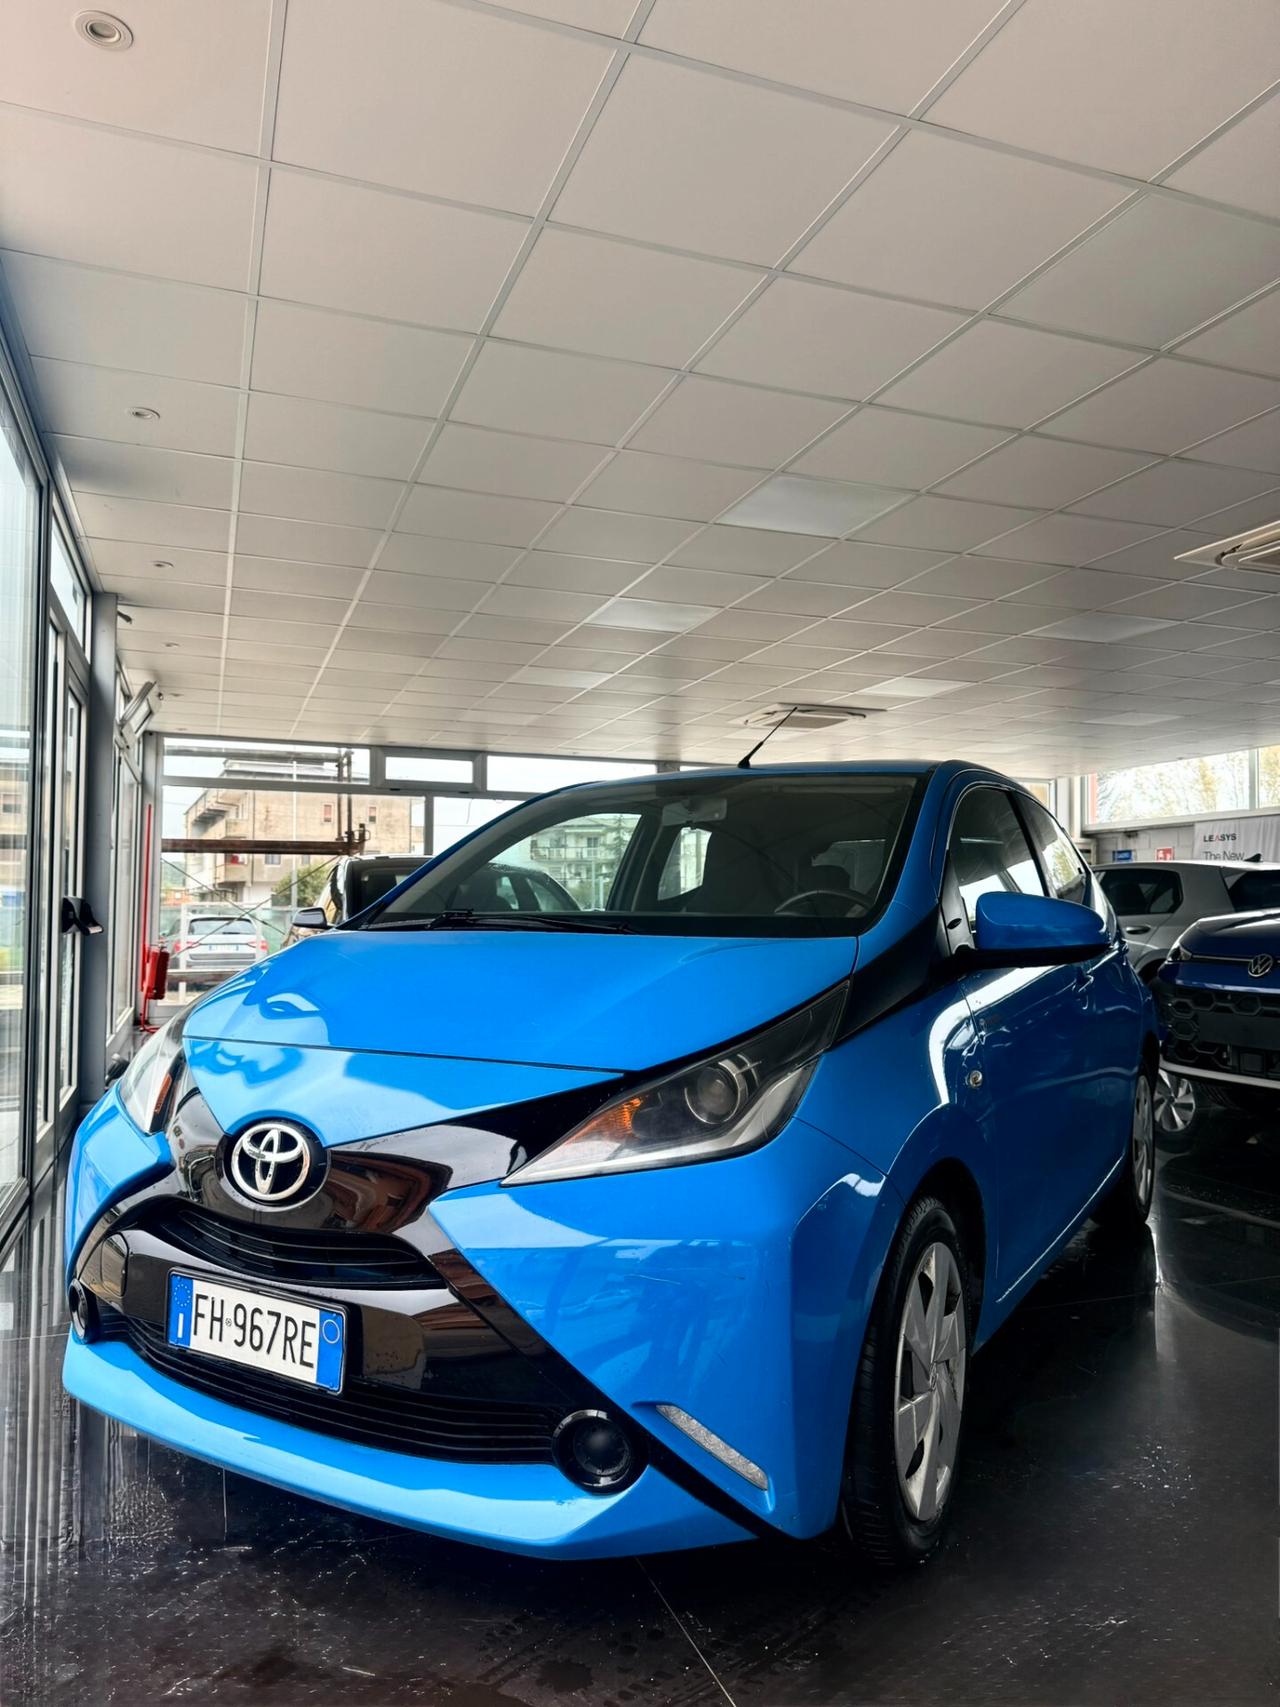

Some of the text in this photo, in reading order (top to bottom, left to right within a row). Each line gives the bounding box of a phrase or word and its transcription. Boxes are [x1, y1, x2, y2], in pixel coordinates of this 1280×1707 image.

[1203, 833, 1237, 842] LEASYS
[1203, 850, 1245, 861] The New
